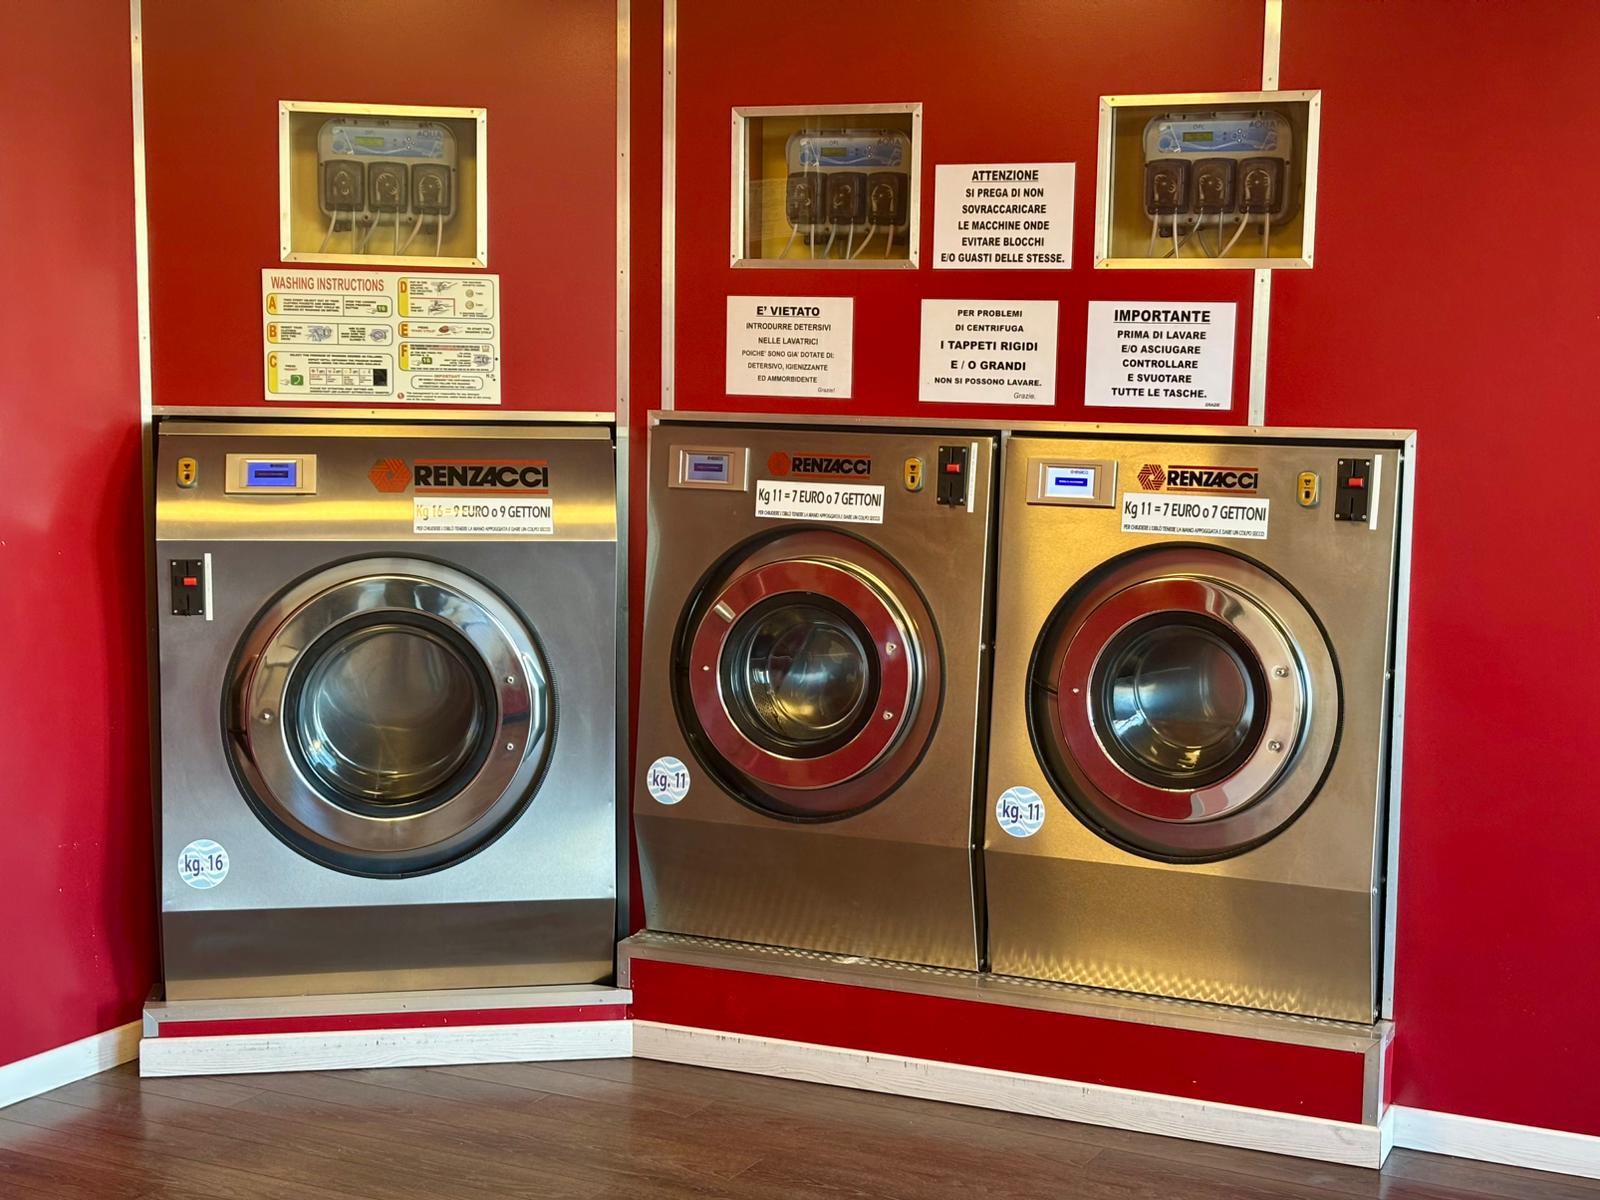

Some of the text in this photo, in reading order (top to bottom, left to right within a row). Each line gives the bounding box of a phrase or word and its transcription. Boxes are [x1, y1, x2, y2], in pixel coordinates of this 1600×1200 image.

[972, 170, 1039, 180] ATTENZIONE
[966, 188, 1044, 197] SI PREGA DI NON
[962, 205, 1046, 214] SOVRACCARICARE
[958, 221, 1049, 230] LE MACCHINE ONDE
[962, 238, 1044, 246] EVITARE BLOCCHI
[941, 253, 1064, 263] E/O GUASTI DELLE STESSE.
[271, 276, 384, 291] WASHING INSTRUCTIONS
[400, 281, 407, 293] D
[269, 297, 276, 309] A
[771, 307, 820, 316] VIETATO
[1114, 310, 1211, 322] IMPORTANTE
[270, 325, 276, 337] B
[401, 324, 408, 336] E
[1117, 330, 1206, 339] PRIMA DI LAVARE
[401, 345, 407, 357] F
[940, 341, 1037, 351] I TAPPETI RIGIDI
[1122, 345, 1200, 354] E/O ASCIUGARE
[270, 355, 277, 367] C
[980, 361, 1026, 370] GRANDI
[1123, 359, 1198, 368] CONTROLLARE
[1137, 374, 1191, 383] SVUOTARE
[1112, 388, 1144, 396] TUTTE
[1163, 389, 1206, 398] TASCHE.
[792, 458, 871, 474] RENZACCI
[414, 466, 548, 487] RENZACCI
[1167, 471, 1258, 488] RENZACCI
[759, 488, 770, 504] Kg
[773, 489, 782, 502] 11
[792, 490, 797, 502] 7
[800, 490, 824, 504] EURO
[826, 495, 832, 504] o
[835, 492, 840, 504] 7
[842, 492, 881, 506] GETTONI
[416, 505, 429, 520] Kg
[454, 505, 459, 517] 9
[462, 506, 489, 517] EURO
[492, 508, 497, 517] o
[500, 506, 505, 517] 9
[508, 506, 550, 518] GETTONI
[1124, 501, 1137, 518] Kg
[1141, 502, 1151, 515] 11
[1164, 503, 1169, 516] 7
[1172, 504, 1200, 517] EURO
[1203, 508, 1209, 518] o
[1212, 506, 1218, 518] 7
[1220, 506, 1266, 521] GETTONI
[653, 769, 685, 791] kg. 11
[1003, 800, 1039, 823] kg. 11
[185, 855, 223, 876] kg. 16
